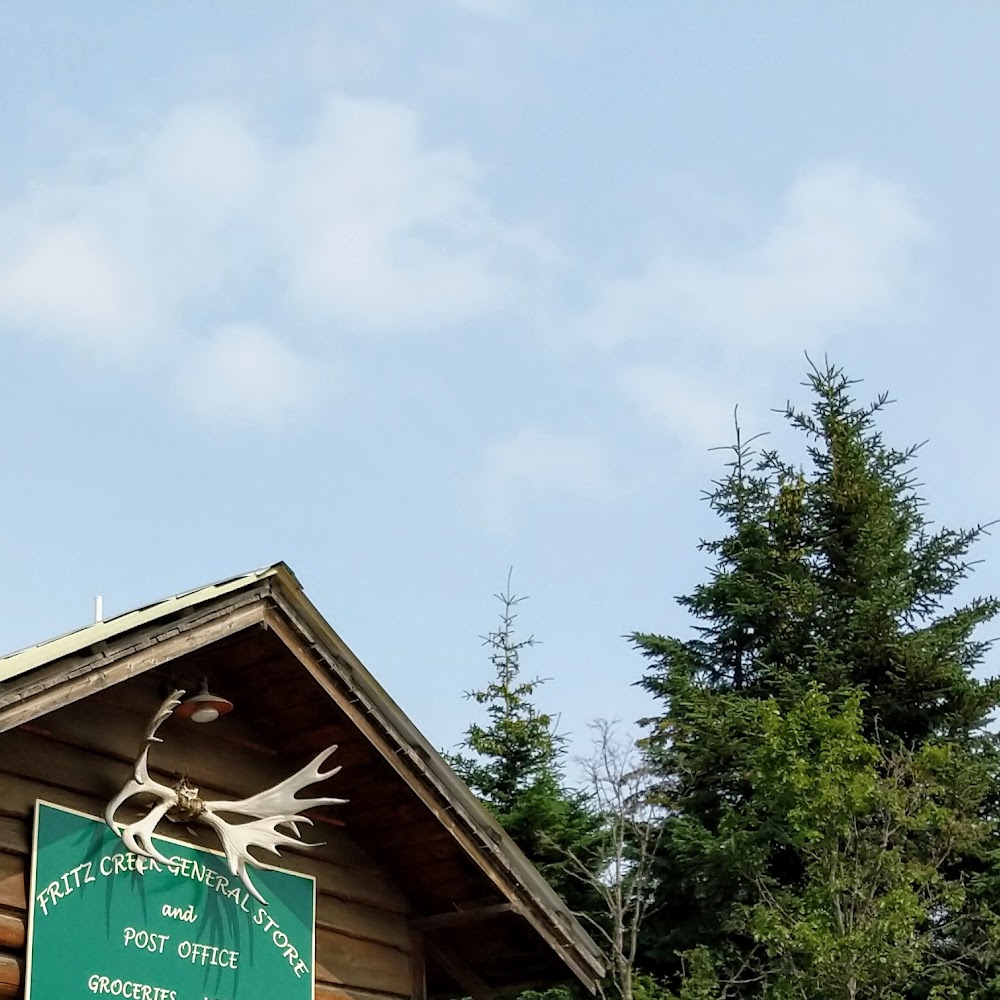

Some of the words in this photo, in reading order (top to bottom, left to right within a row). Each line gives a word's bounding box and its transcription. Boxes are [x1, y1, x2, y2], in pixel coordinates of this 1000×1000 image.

[35, 861, 96, 915] FRITZ
[167, 855, 251, 912] GENERAL
[252, 907, 309, 979] STORE
[161, 904, 198, 923] and
[123, 927, 170, 953] POST
[177, 940, 240, 969] OFFICE
